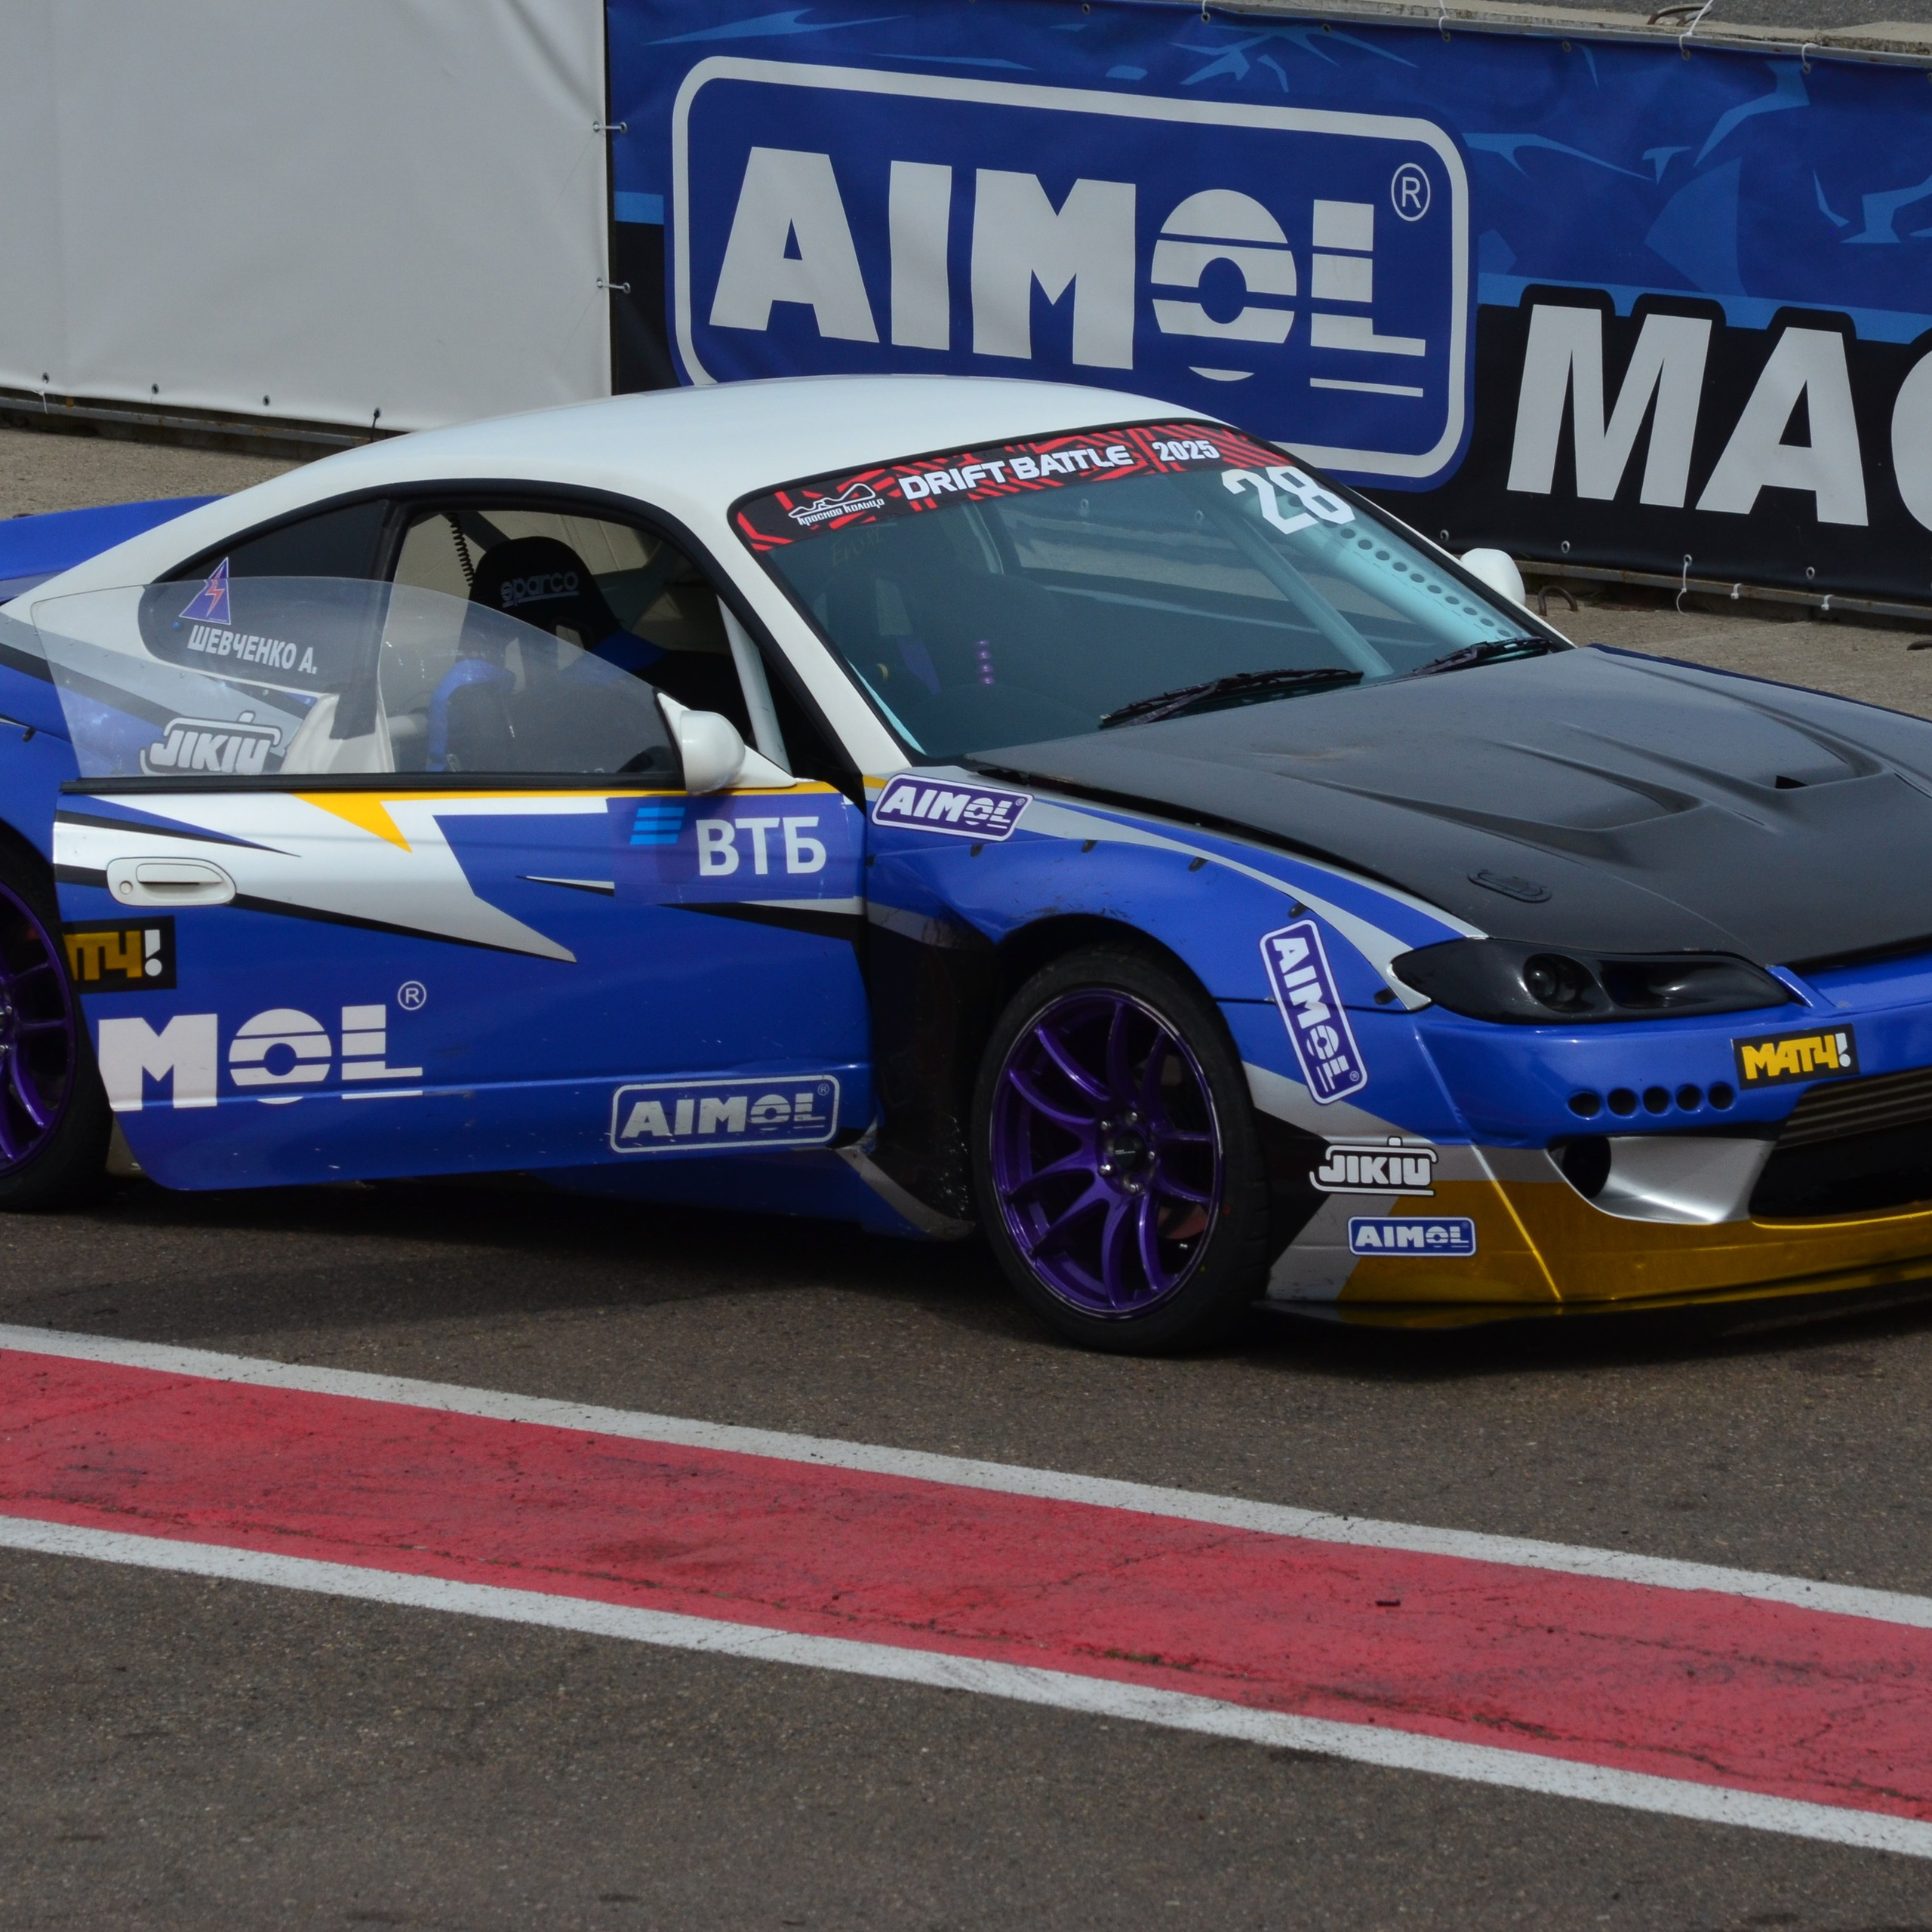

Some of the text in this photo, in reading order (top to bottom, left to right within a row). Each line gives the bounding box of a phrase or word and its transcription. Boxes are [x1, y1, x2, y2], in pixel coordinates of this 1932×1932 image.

[1507, 304, 1932, 533] МА
[898, 440, 1220, 500] DRIFT BATTLE 2025
[1221, 466, 1355, 534] 28
[500, 571, 579, 608] sparco
[187, 625, 318, 674] ШЕВЧЕНКО А.
[696, 816, 826, 875] ВТБ
[1318, 1137, 1430, 1186] JIKIU
[1355, 1226, 1469, 1247] AIMOL
